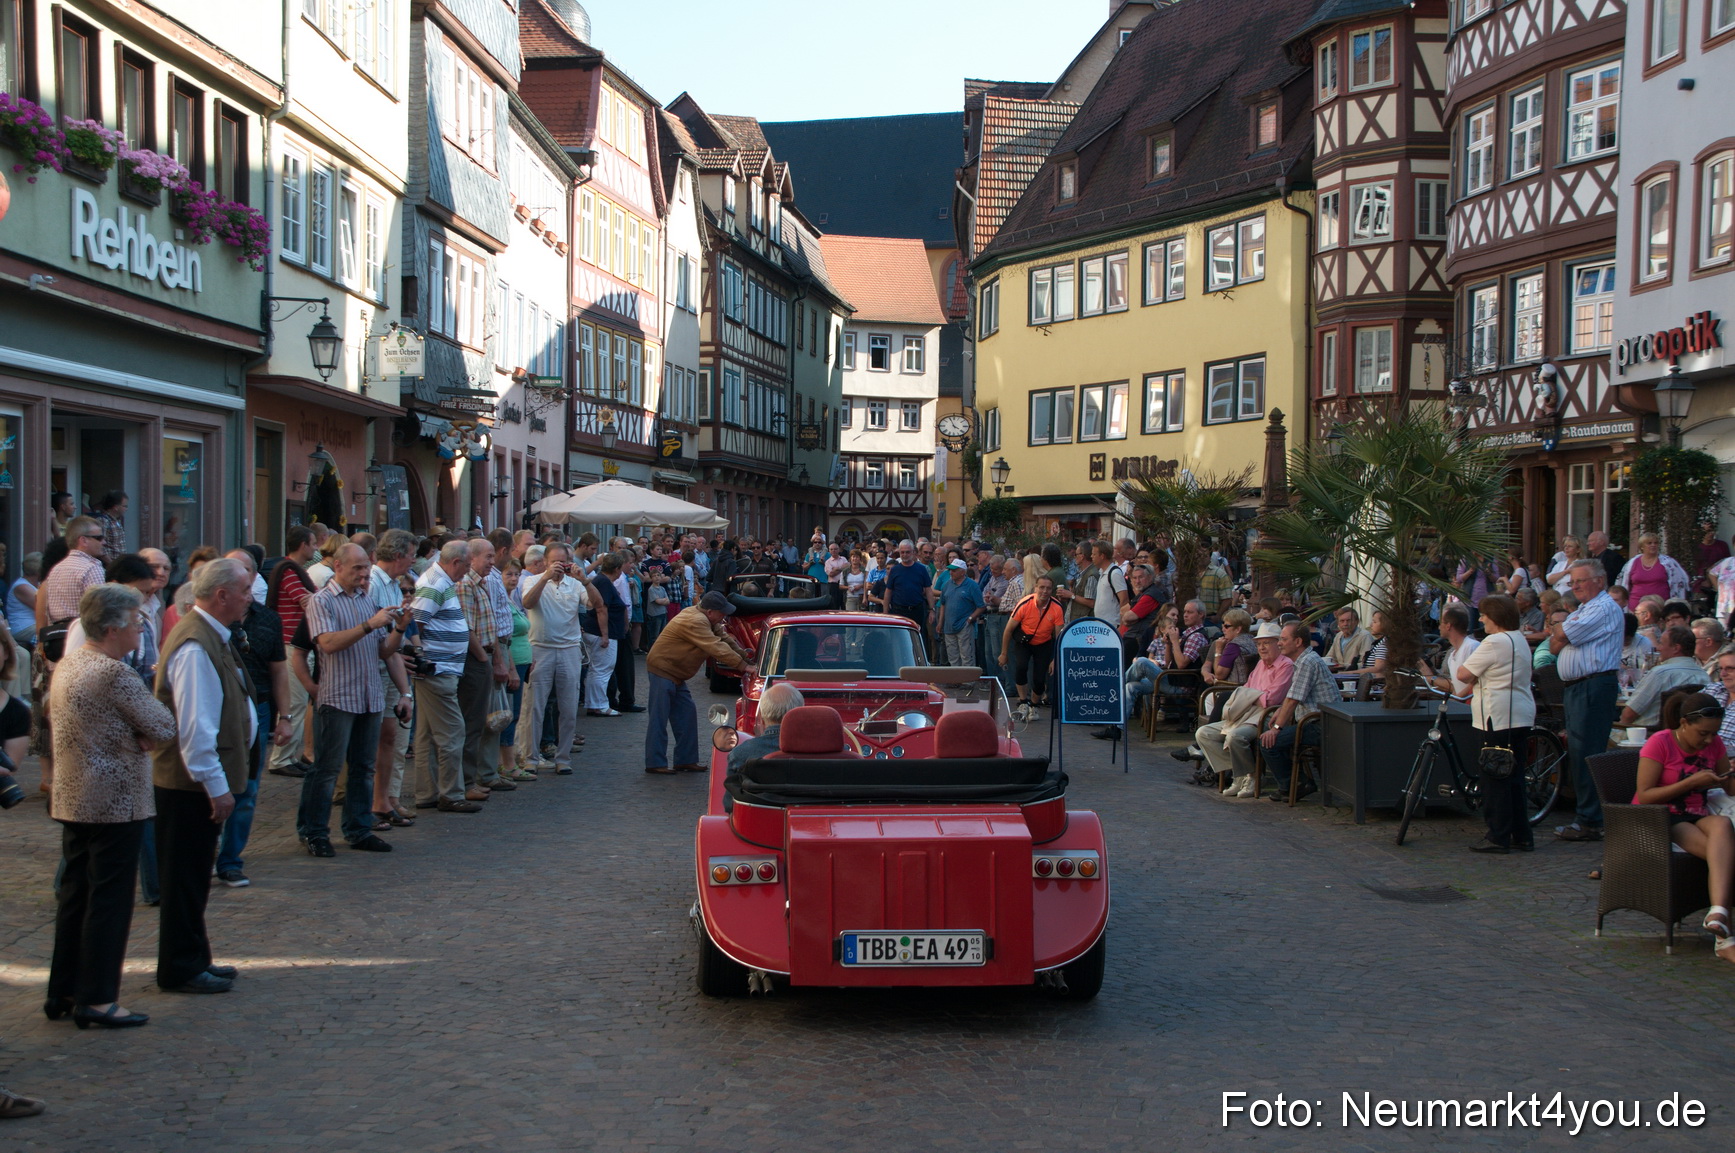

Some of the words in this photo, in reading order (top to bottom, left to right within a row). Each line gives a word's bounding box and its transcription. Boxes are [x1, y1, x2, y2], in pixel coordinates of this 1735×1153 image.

[71, 187, 203, 293] Rehbein
[1616, 310, 1722, 376] prooptik
[384, 349, 398, 357] Zum
[399, 348, 421, 357] Ochsen
[441, 401, 457, 409] FRITZ
[1569, 422, 1635, 438] Rauchwaren
[1111, 455, 1179, 480] Müller
[1071, 625, 1111, 637] GEROLSTEINER
[1069, 650, 1105, 662] Warmer
[1067, 668, 1120, 680] Apfelstrudel
[1082, 681, 1098, 689] mit
[1067, 692, 1106, 702] Vanilleeis
[1108, 689, 1119, 703] &
[1078, 704, 1110, 716] Sahne
[970, 937, 981, 945] 05
[847, 951, 854, 959] D
[858, 938, 897, 960] TBB
[913, 938, 939, 960] EA
[944, 938, 969, 960] 49
[971, 952, 981, 960] 10
